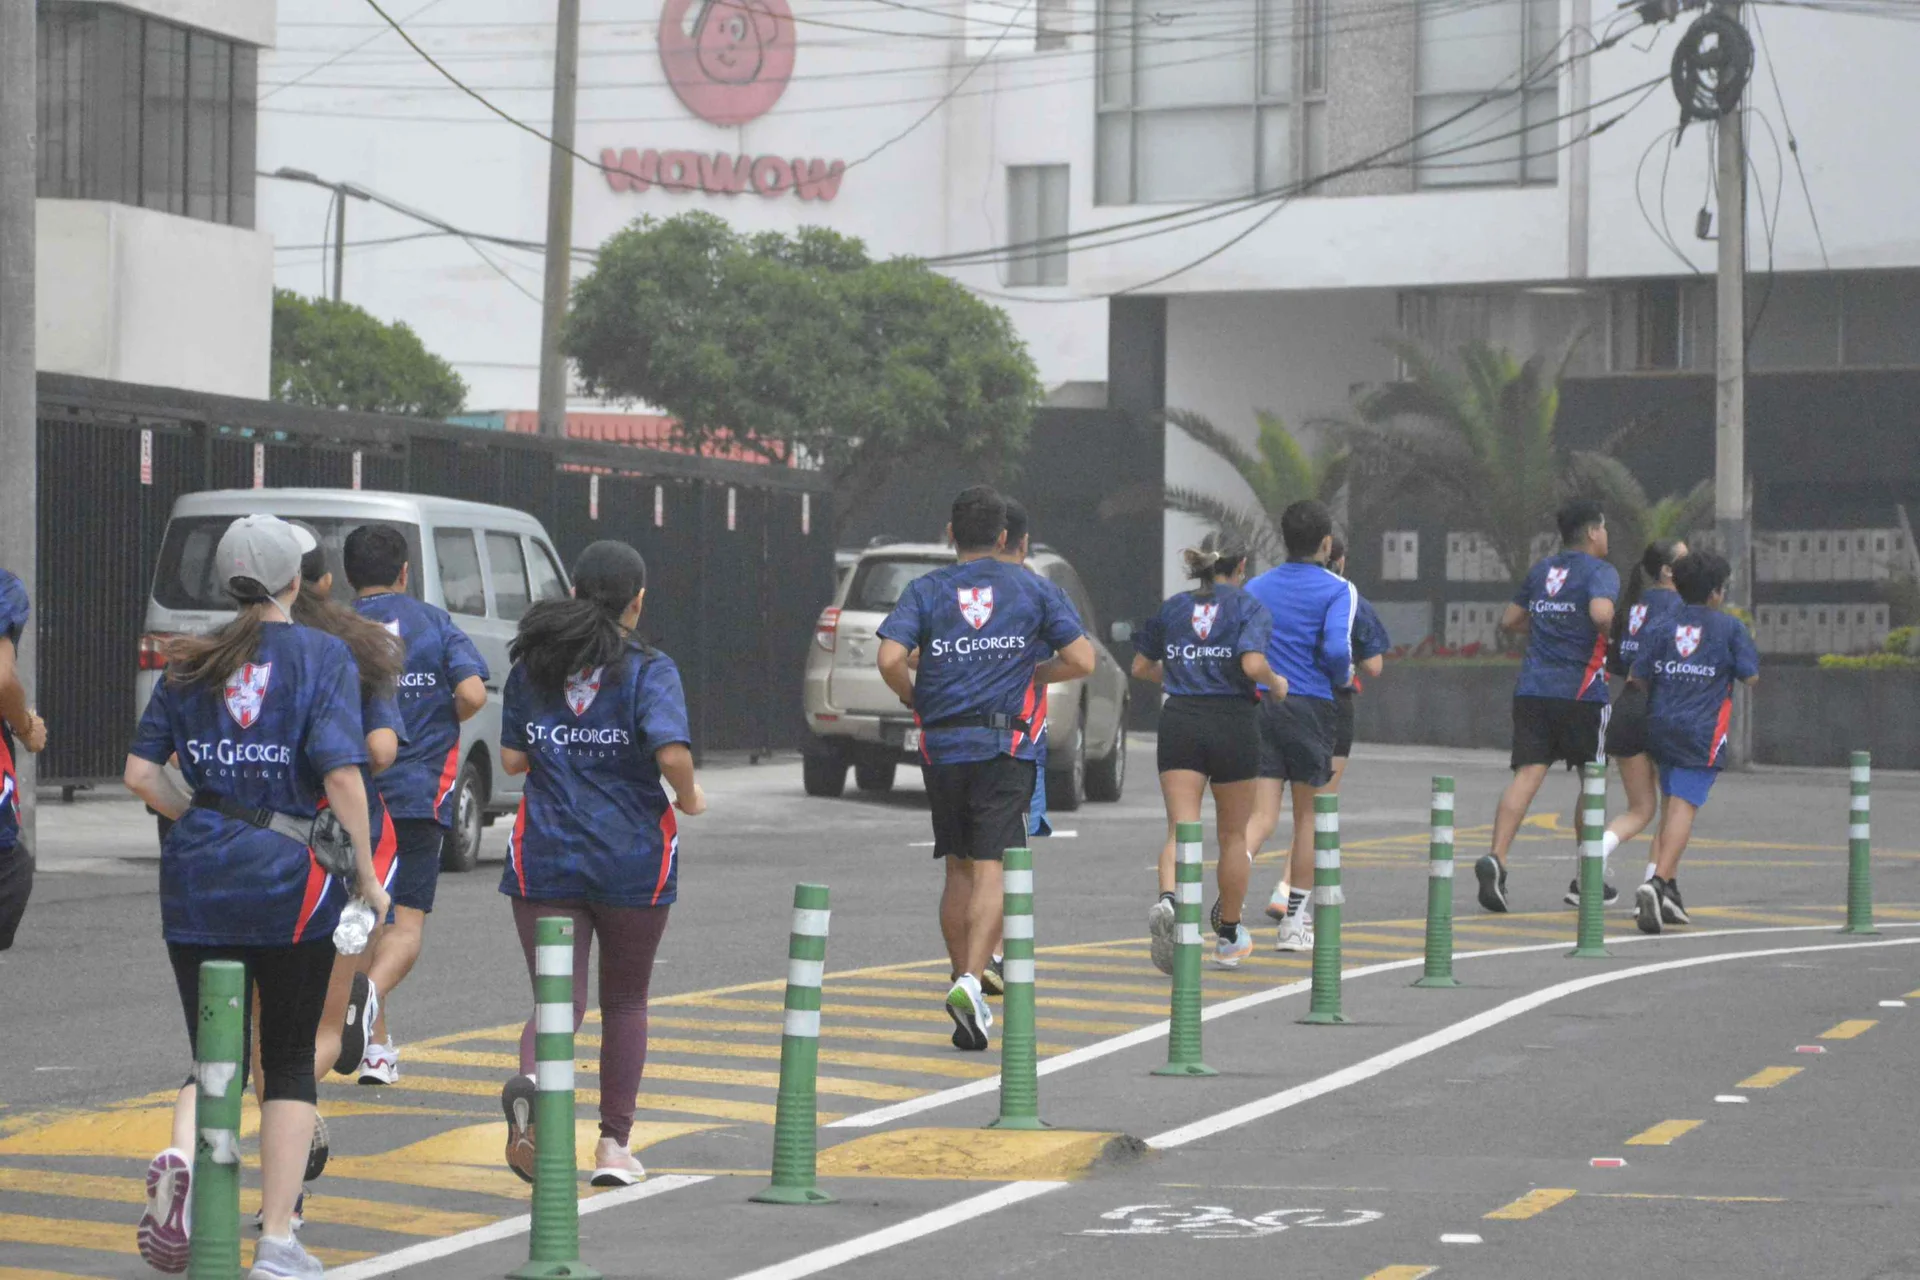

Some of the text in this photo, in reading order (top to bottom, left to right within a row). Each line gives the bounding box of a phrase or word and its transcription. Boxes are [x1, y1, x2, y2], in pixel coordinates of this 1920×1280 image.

[600, 147, 846, 202] WOWOW
[932, 636, 1025, 656] ST. GEORGE'S
[526, 722, 629, 745] ST. GEORGE'S
[187, 739, 213, 764] ST.
